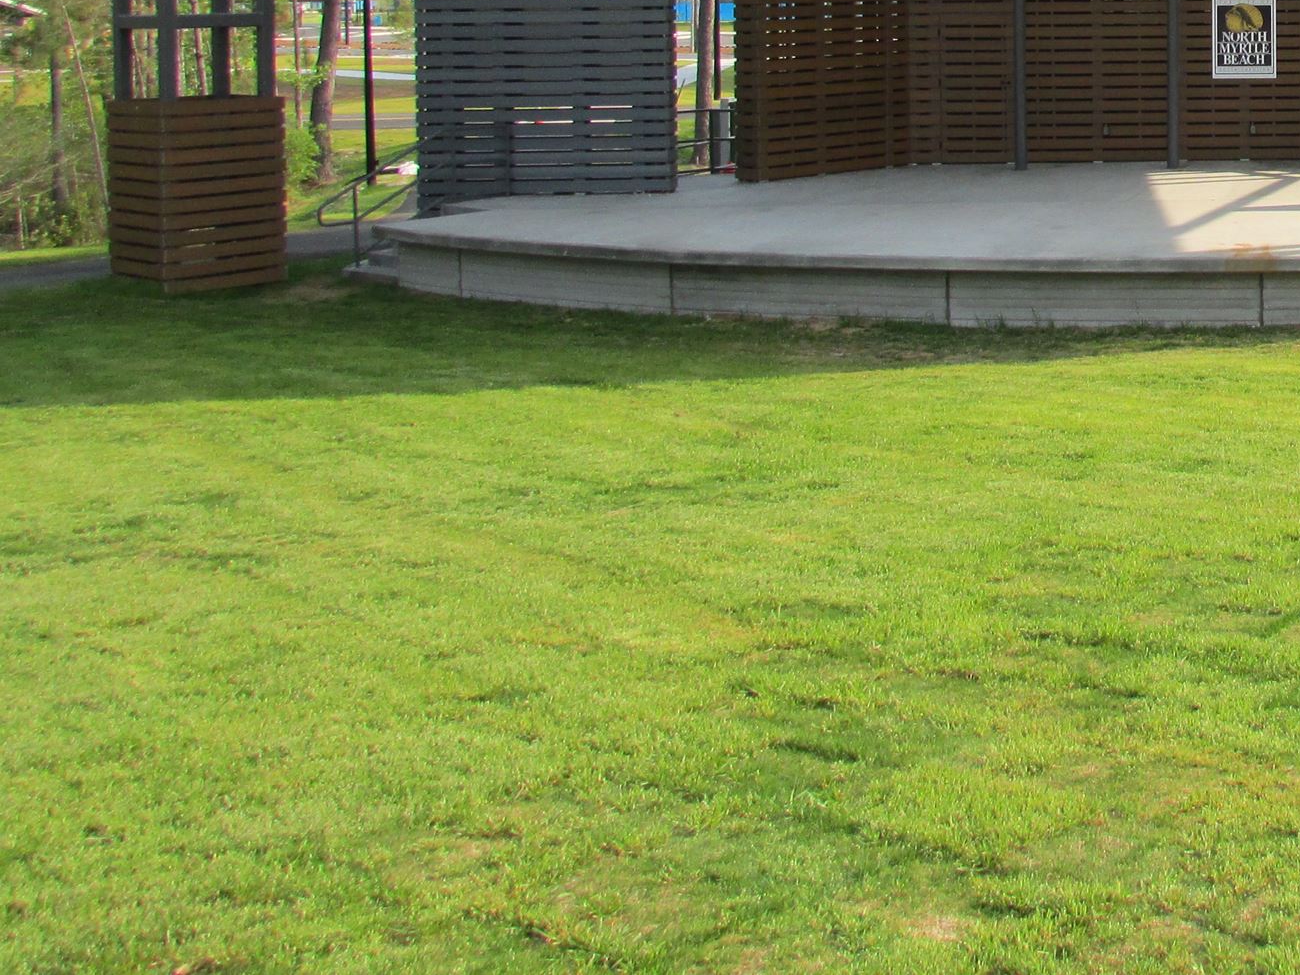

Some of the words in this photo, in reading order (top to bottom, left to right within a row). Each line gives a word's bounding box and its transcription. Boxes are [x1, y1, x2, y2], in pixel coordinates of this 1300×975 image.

[1222, 31, 1267, 43] NORTH
[1219, 42, 1270, 54] MYRTLE
[1223, 54, 1265, 65] BEACH
